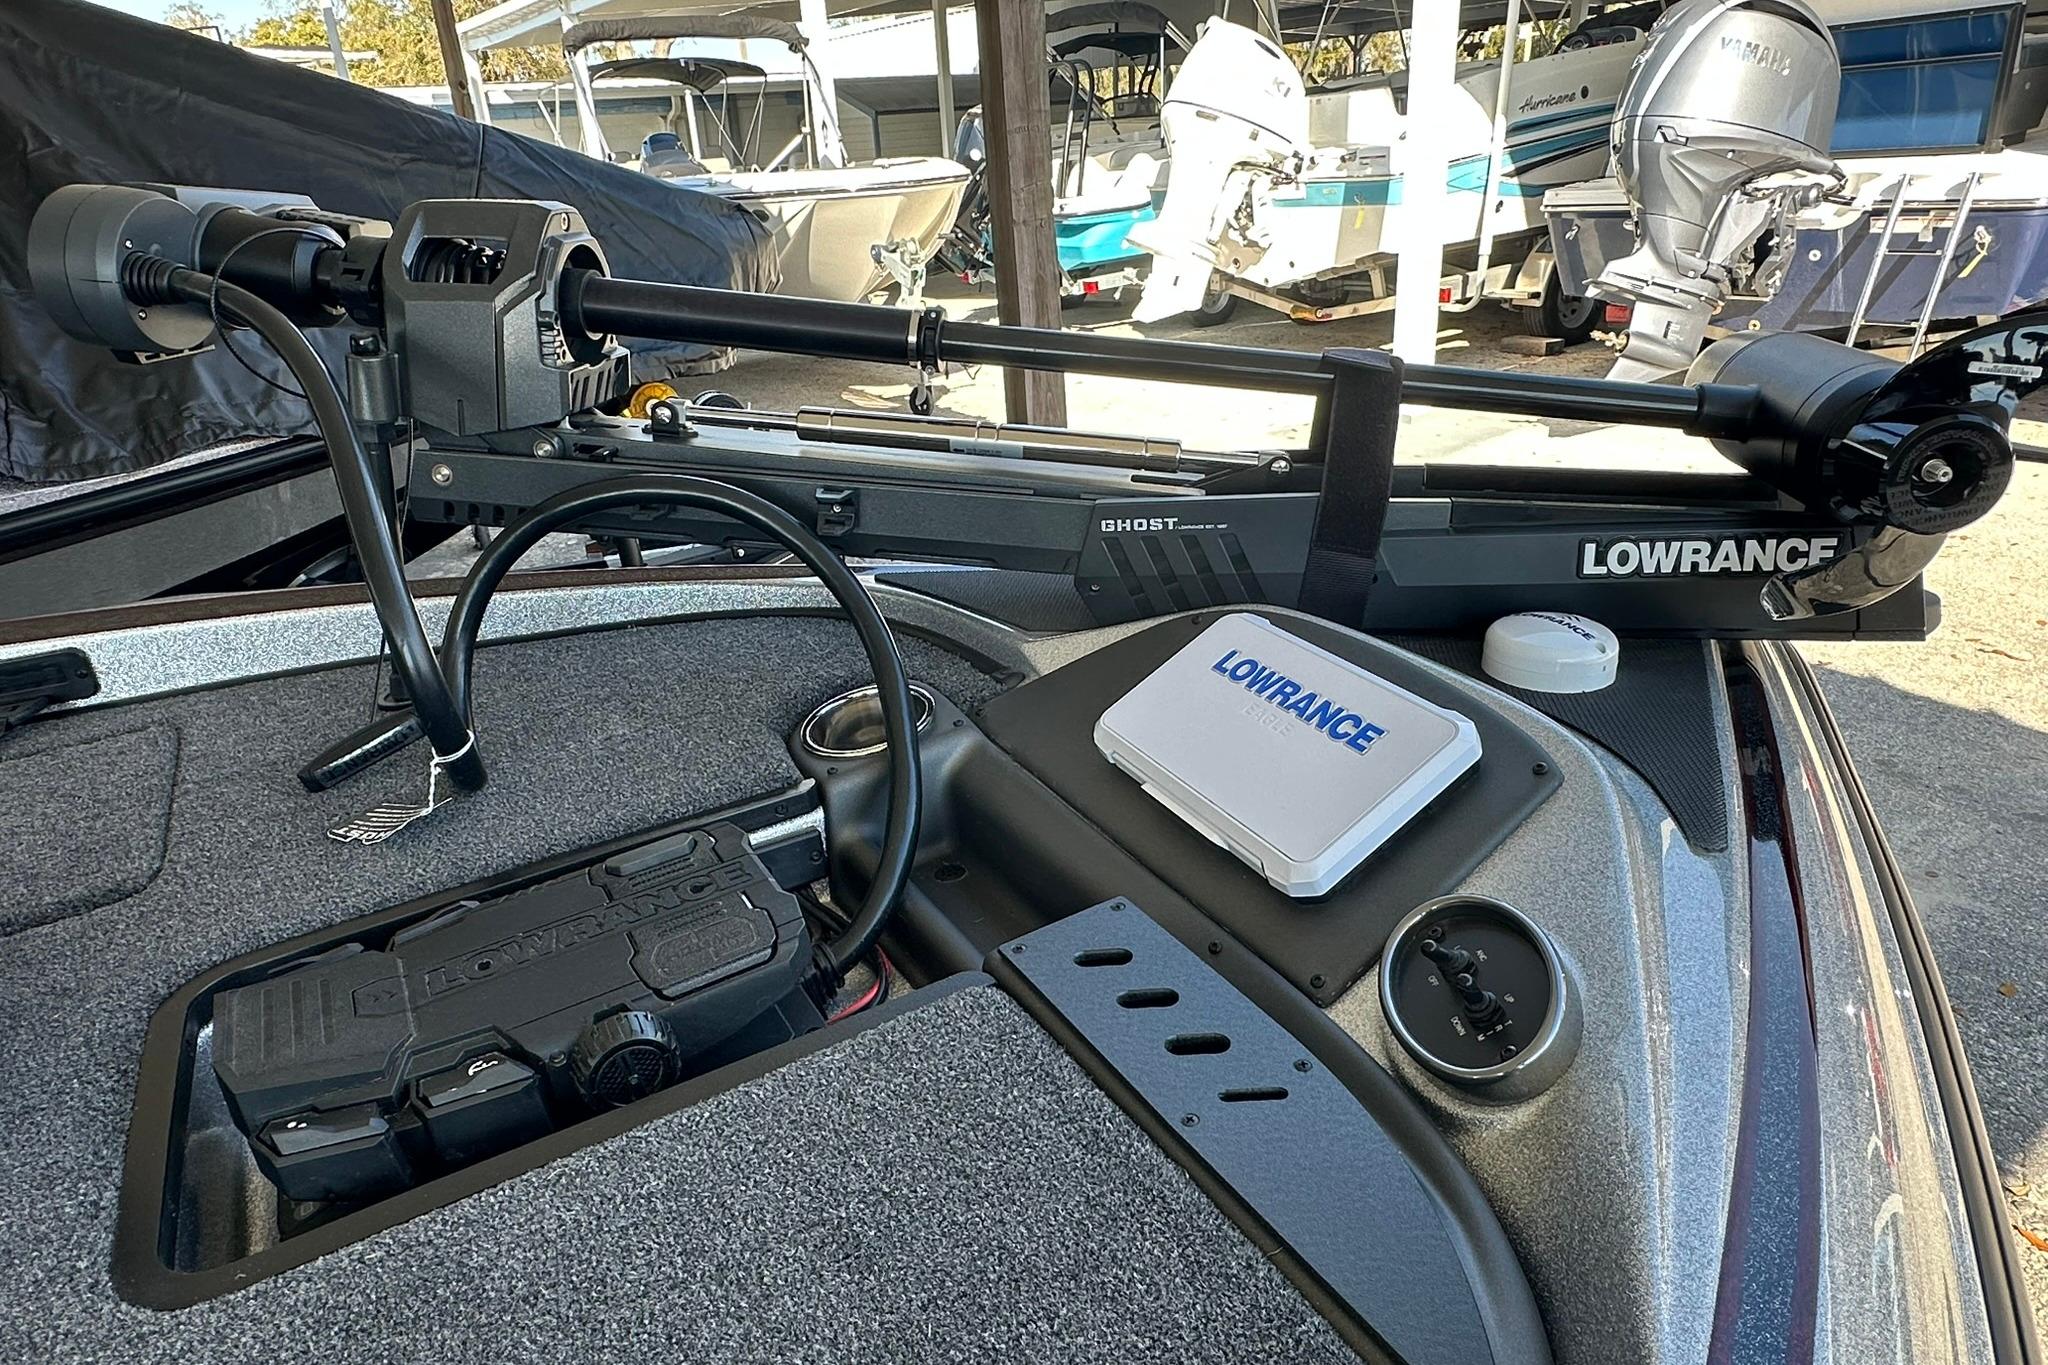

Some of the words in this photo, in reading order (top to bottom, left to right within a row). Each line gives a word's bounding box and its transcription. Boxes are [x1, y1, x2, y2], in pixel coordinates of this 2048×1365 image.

[1518, 91, 1577, 114] Hurricane
[1101, 517, 1179, 532] GHOST
[1583, 537, 1838, 575] LOWRANCE
[1512, 612, 1596, 641] WRANCE
[1211, 648, 1388, 755] LOWRANCE
[1242, 703, 1295, 738] EAGLE
[424, 860, 752, 998] LOWRANCE
[1427, 975, 1439, 986] OFF
[1503, 993, 1514, 1003] UP
[1450, 1015, 1466, 1035] DOWN
